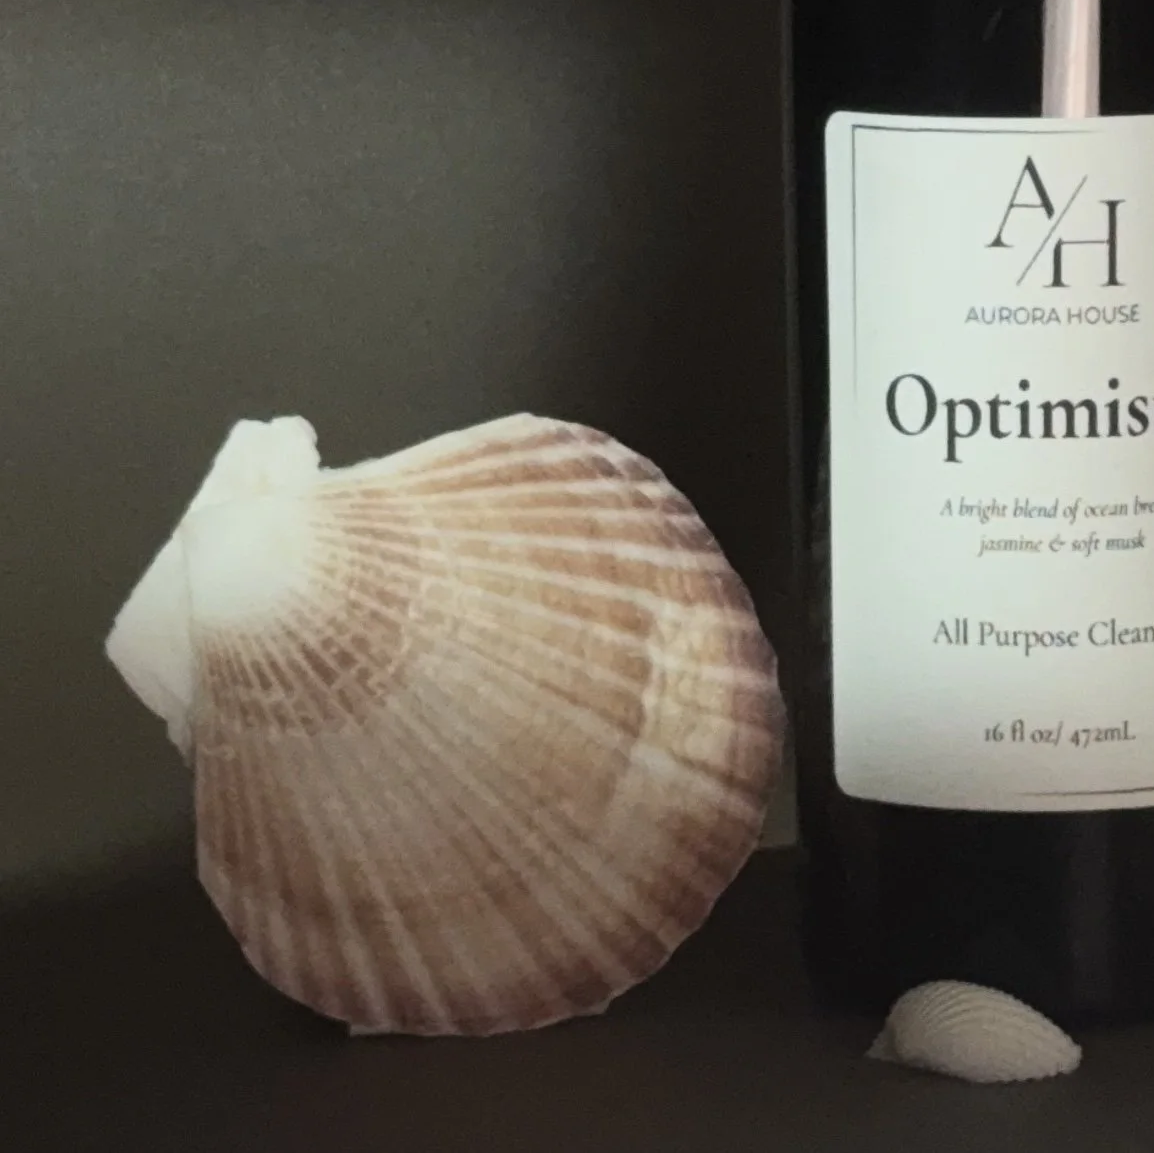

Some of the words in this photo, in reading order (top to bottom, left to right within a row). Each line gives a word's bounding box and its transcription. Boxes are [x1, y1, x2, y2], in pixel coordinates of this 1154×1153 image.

[964, 307, 1061, 325] AURORA
[1067, 304, 1141, 325] HOUSE
[940, 498, 954, 516] A
[959, 495, 1008, 524] bright
[1013, 496, 1058, 519] blend
[1063, 496, 1081, 524] of
[1083, 502, 1128, 517] ocean
[977, 535, 1043, 557] jasmine
[1049, 534, 1066, 552] &
[1071, 532, 1101, 557] soft
[1106, 529, 1146, 551] musk
[933, 618, 969, 646] All
[977, 622, 1080, 657] Purpose
[984, 722, 1004, 742] 16
[1010, 719, 1025, 741] fl
[1070, 719, 1136, 747] 472mL
